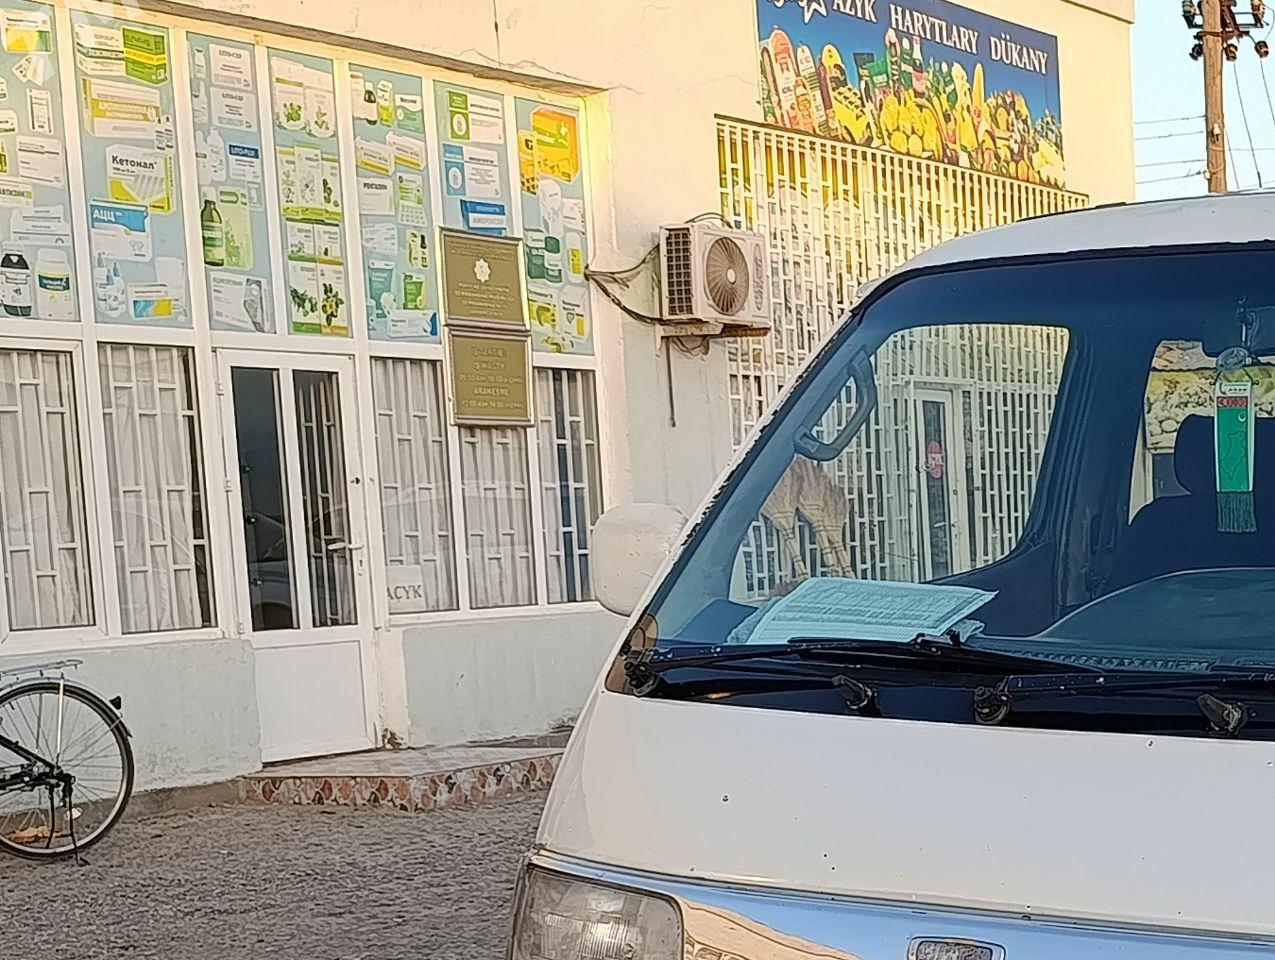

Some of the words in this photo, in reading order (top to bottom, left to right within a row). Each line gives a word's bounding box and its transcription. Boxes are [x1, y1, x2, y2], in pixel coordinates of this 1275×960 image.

[889, 4, 979, 55] HARYTLARY
[989, 33, 1049, 75] DÜKANY
[93, 209, 116, 222] АЦЦ
